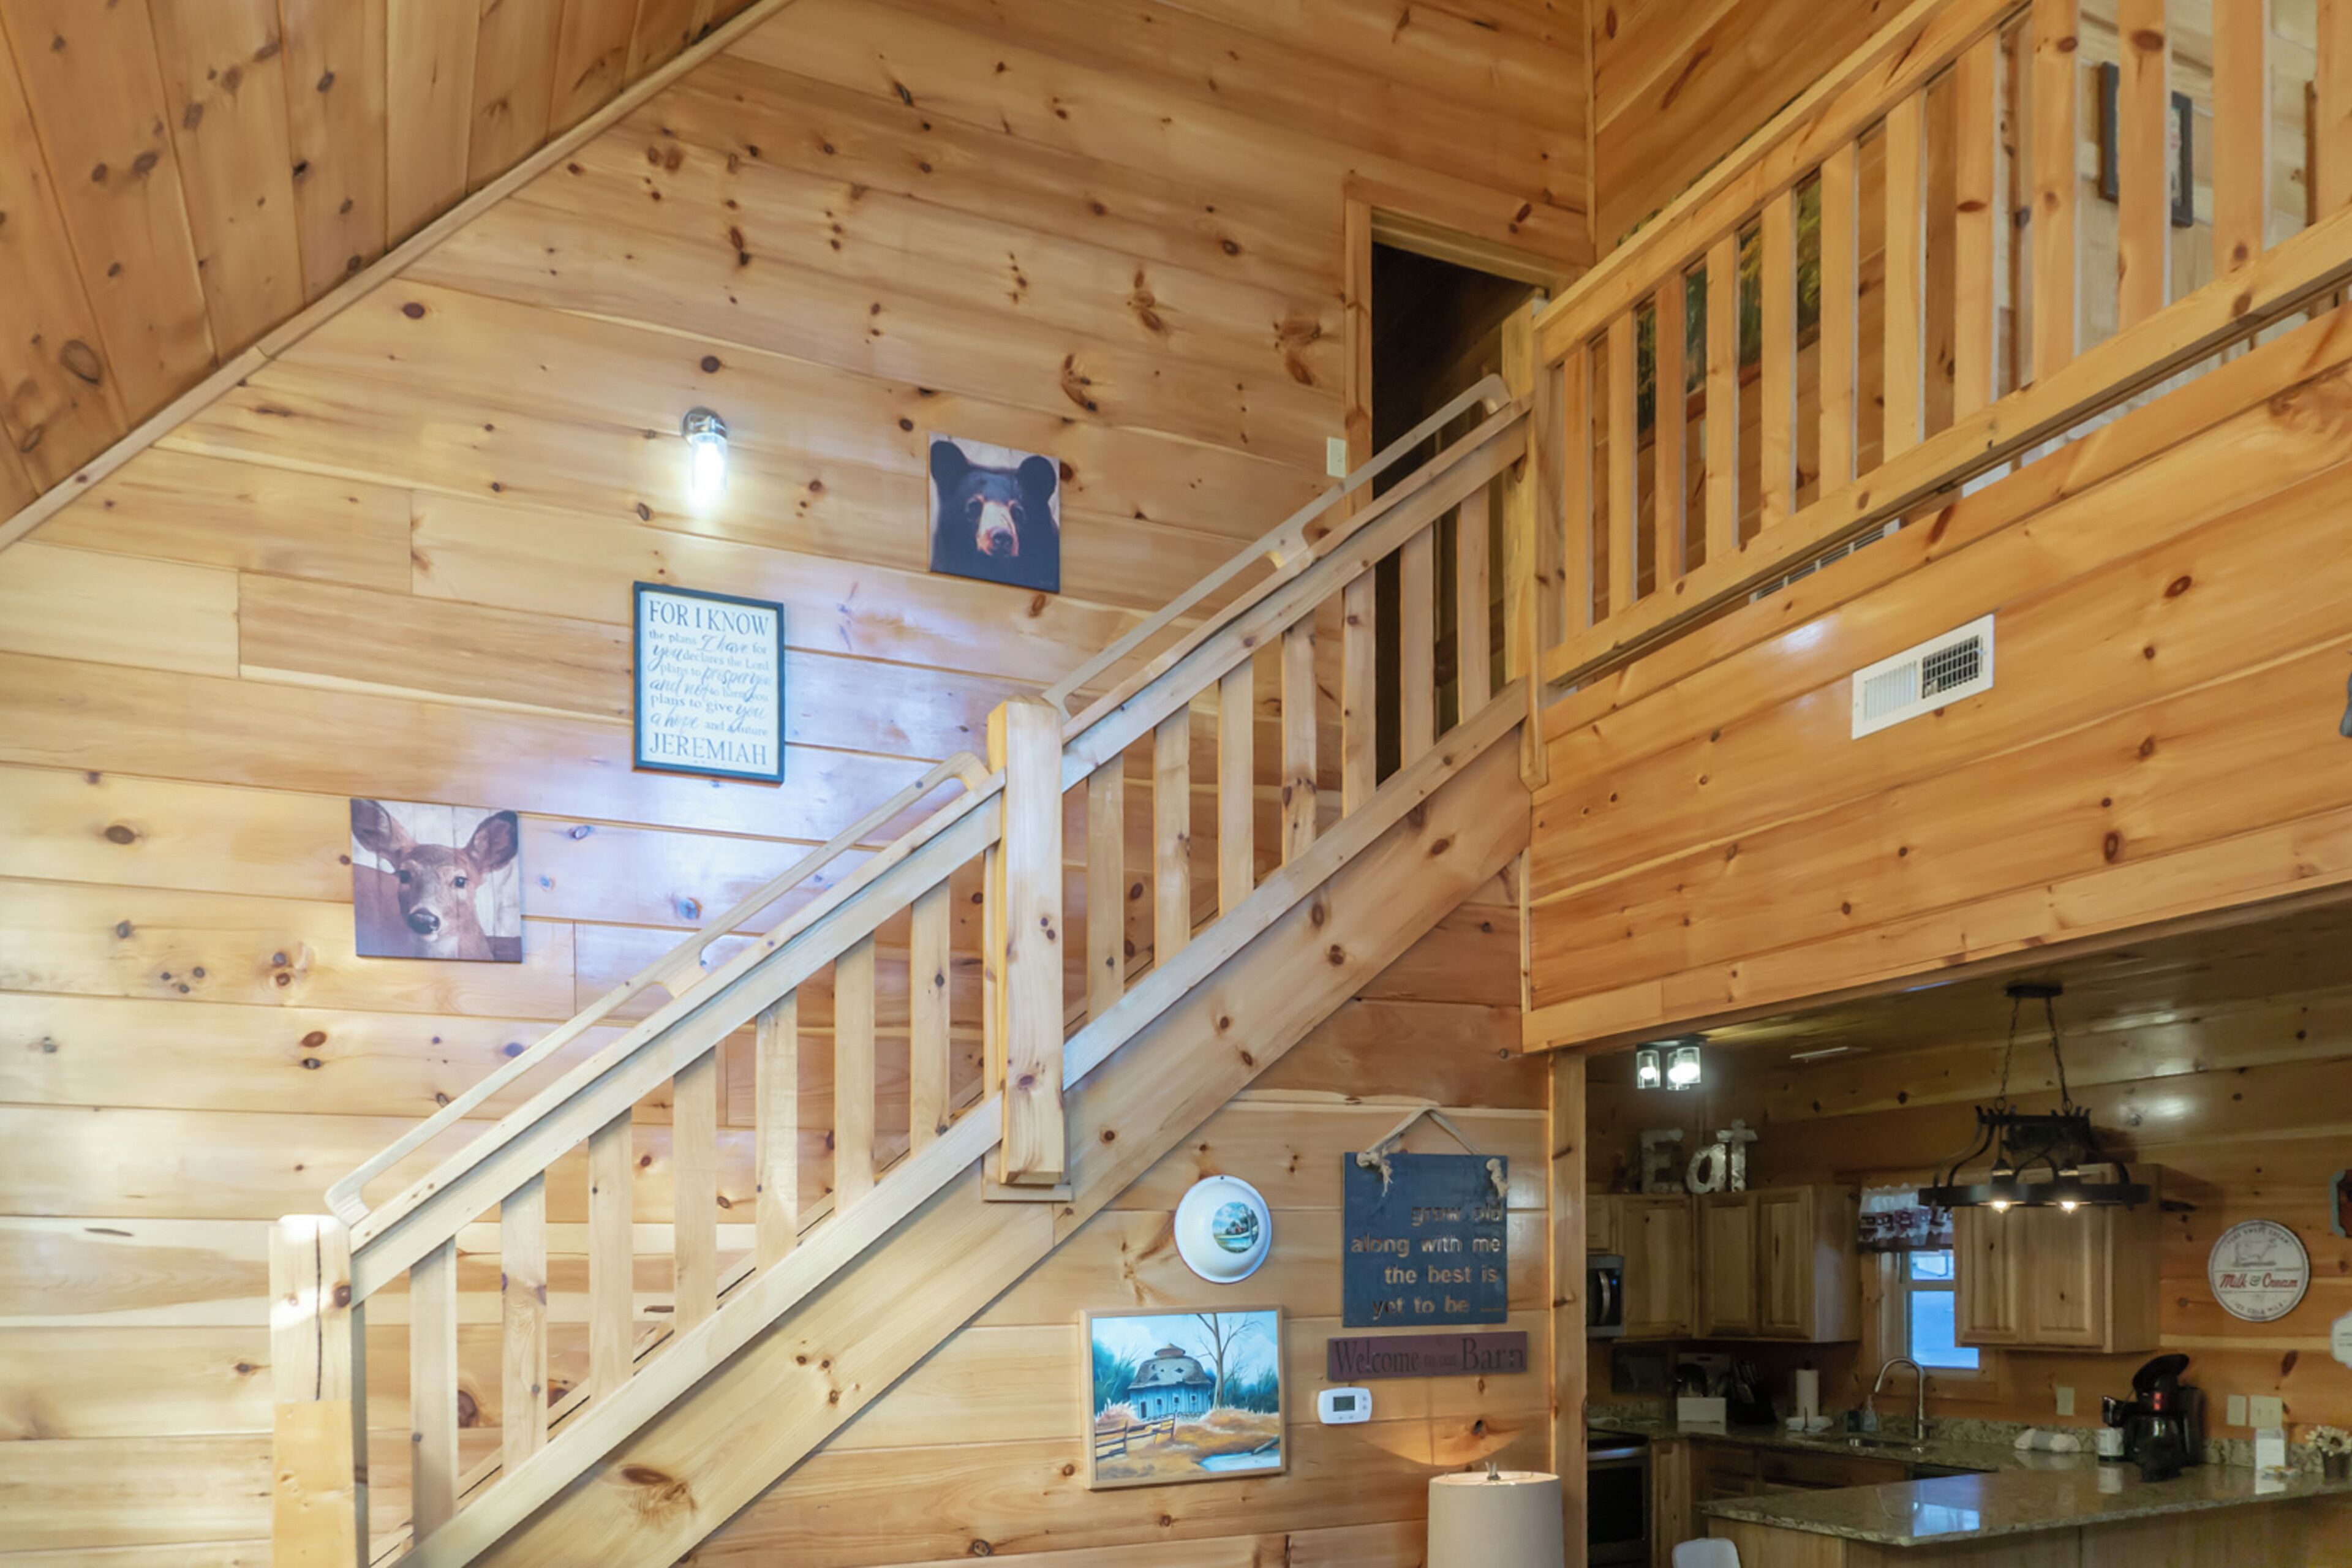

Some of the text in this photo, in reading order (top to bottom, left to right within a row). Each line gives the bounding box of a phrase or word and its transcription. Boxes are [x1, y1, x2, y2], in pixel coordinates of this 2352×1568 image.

[649, 599, 769, 636] FOR I KNOW
[649, 629, 665, 640] the
[668, 632, 696, 646] plans
[717, 635, 748, 654] have
[752, 643, 766, 655] for
[648, 645, 769, 672] you declares the Lord
[660, 662, 687, 676] plans
[691, 668, 701, 677] to
[649, 674, 684, 696] and
[650, 693, 685, 707] plans
[689, 698, 701, 709] to
[705, 701, 734, 714] give
[650, 712, 662, 726] a
[665, 706, 699, 734] hope
[705, 721, 725, 732] and
[649, 733, 767, 766] JEREMIAH
[1641, 1119, 1758, 1194] Eat
[1411, 1202, 1502, 1227] grow old
[1351, 1232, 1501, 1258] along with me
[1384, 1264, 1499, 1284] the best is
[2220, 1272, 2299, 1289] Milk & Cream
[1372, 1294, 1470, 1321] yet to be
[1334, 1340, 1420, 1374] Welcome
[1424, 1354, 1436, 1367] to
[1461, 1336, 1524, 1372] Barn
